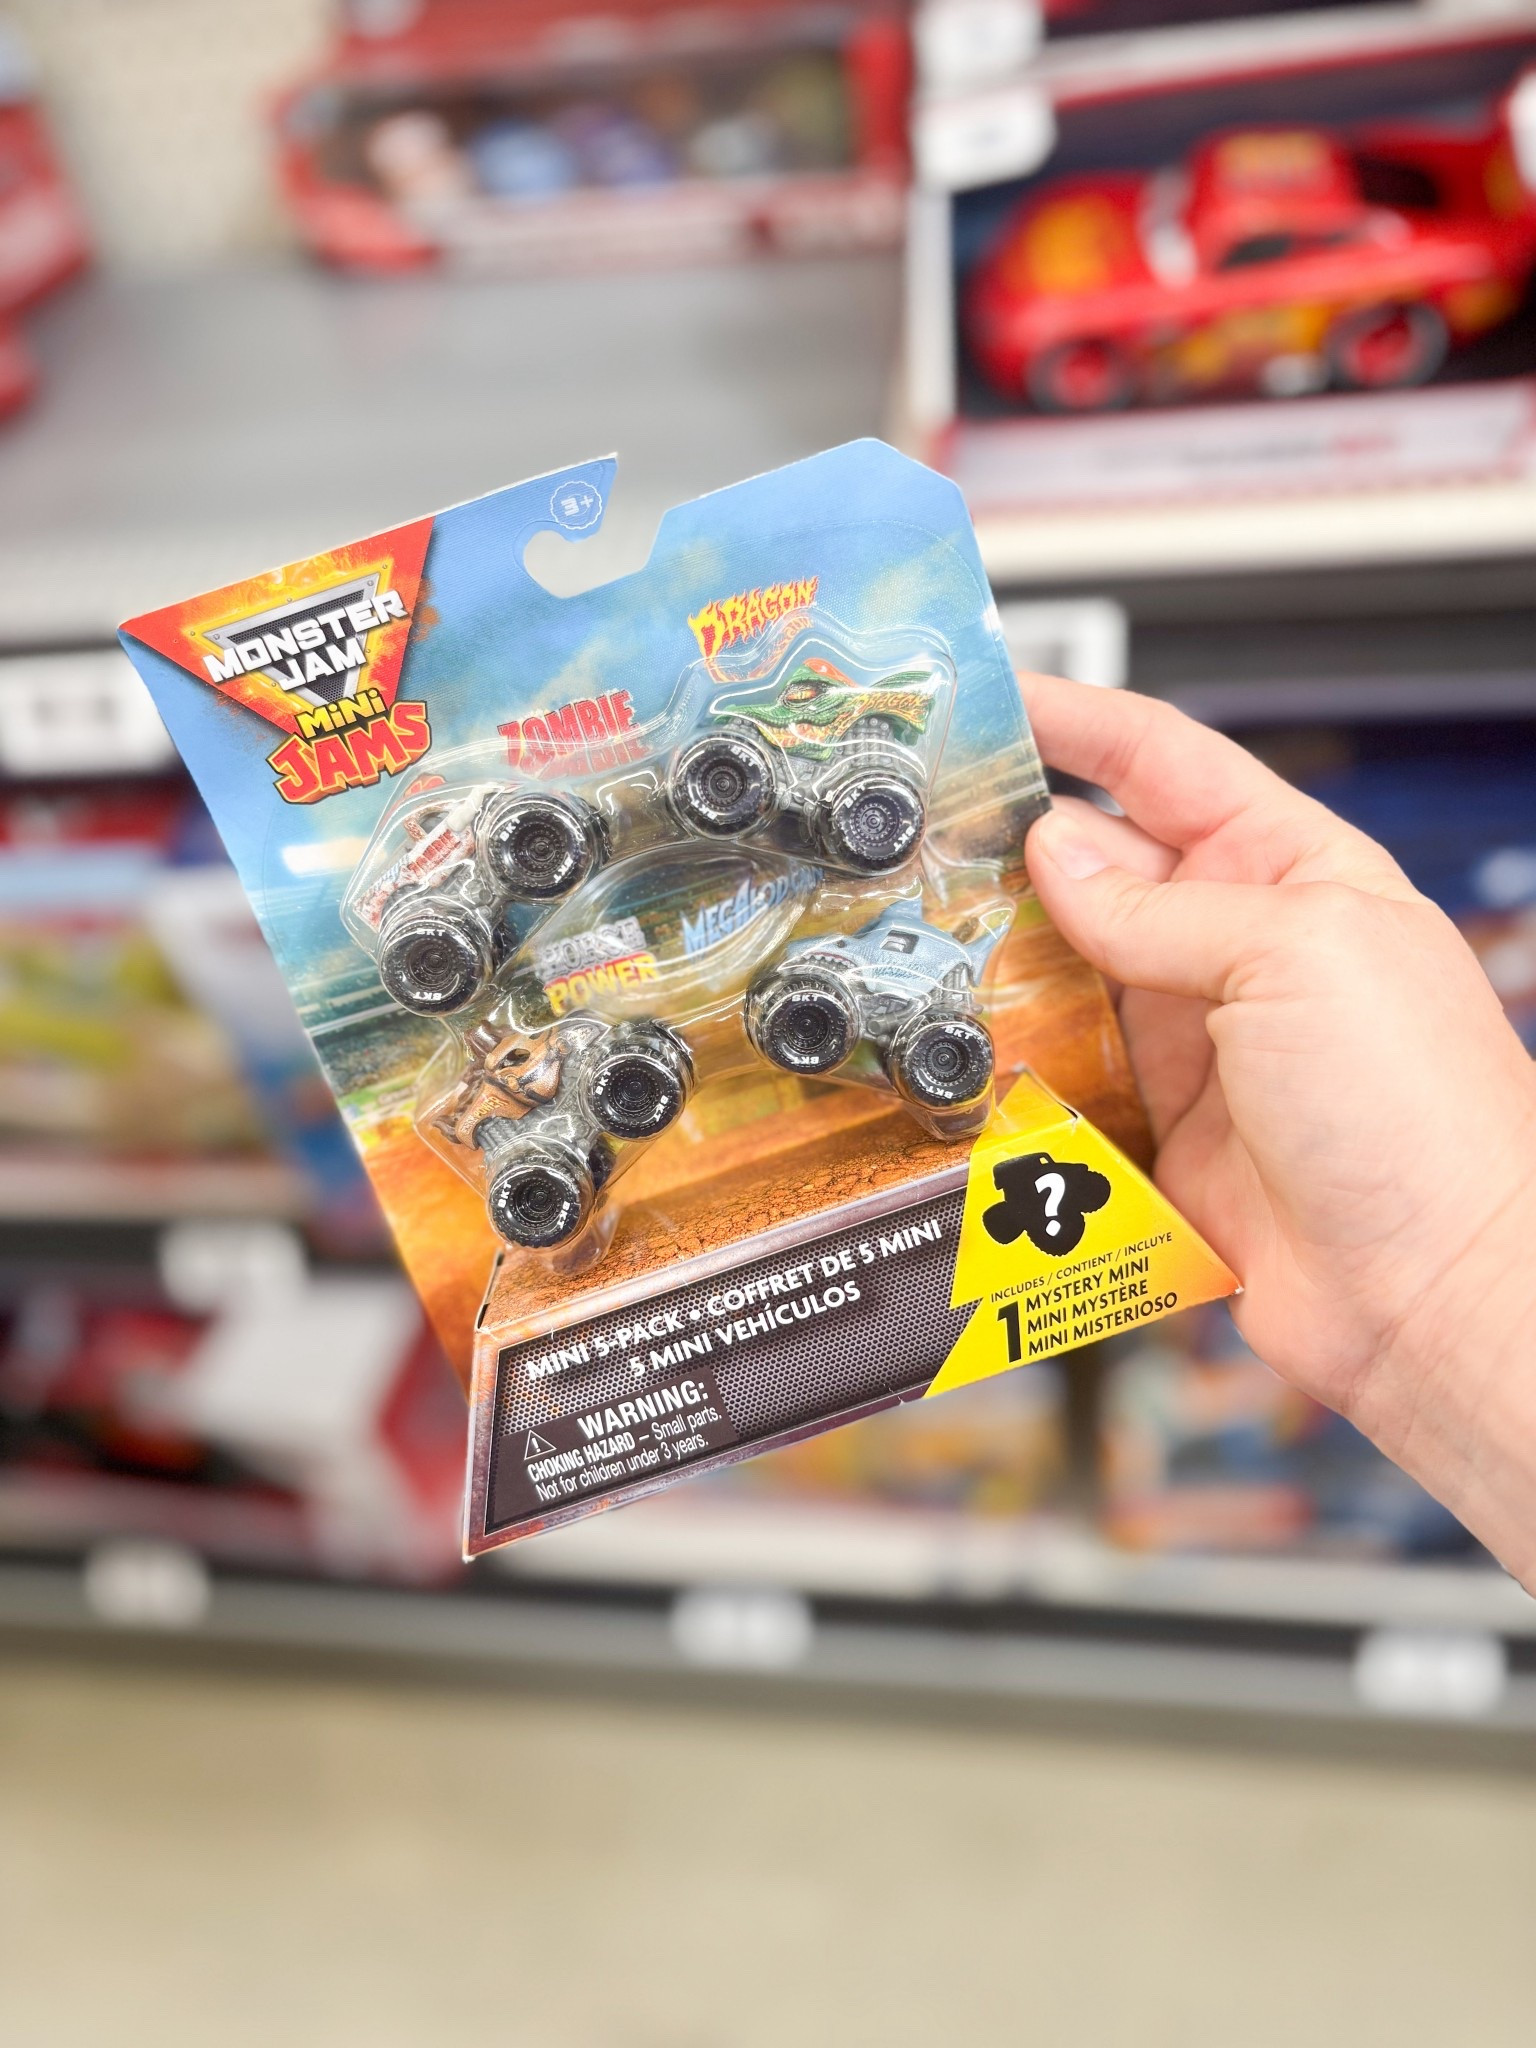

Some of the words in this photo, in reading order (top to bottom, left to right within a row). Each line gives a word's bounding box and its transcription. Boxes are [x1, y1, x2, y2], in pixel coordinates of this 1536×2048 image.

[560, 494, 594, 517] 3+
[203, 590, 408, 683] MONSTER
[687, 576, 819, 661] DRAGON
[277, 636, 367, 691] JAM
[266, 701, 432, 805] JAMS
[496, 689, 640, 768] ZOMBIE
[500, 816, 521, 842] BKT
[543, 951, 660, 1016] POWER
[1034, 1172, 1067, 1237] ?
[526, 1342, 591, 1380] MINI
[593, 1309, 685, 1358] 5-PACK
[707, 1263, 815, 1316] COFFRET
[820, 1248, 857, 1278] DE
[858, 1242, 875, 1265] 5
[877, 1219, 943, 1258] MINI
[991, 1276, 1045, 1303] INCLUDES
[1056, 1252, 1113, 1280] CONTIENT
[1124, 1231, 1173, 1257] INCLUYE
[1026, 1271, 1104, 1313] MYSTERY
[1108, 1256, 1149, 1284] MINI
[629, 1356, 646, 1377] 5
[649, 1332, 713, 1371] MINI
[714, 1280, 861, 1346] VEHÍCULOS
[997, 1300, 1022, 1363] 1
[1027, 1307, 1067, 1334] MINI
[1072, 1279, 1149, 1319] MYSTÈRE
[1028, 1329, 1069, 1356] MINI
[1073, 1291, 1178, 1341] MISTERIOSO
[576, 1379, 710, 1440] WARNING:
[527, 1448, 586, 1482] CHOKING
[583, 1431, 636, 1463] HAZARD
[651, 1413, 686, 1441] Small
[686, 1405, 722, 1434] parts.
[535, 1480, 562, 1501] Not
[560, 1475, 578, 1493] for
[580, 1460, 627, 1487] children
[626, 1448, 661, 1471] under
[661, 1441, 672, 1459] 3
[672, 1433, 709, 1461] years.
